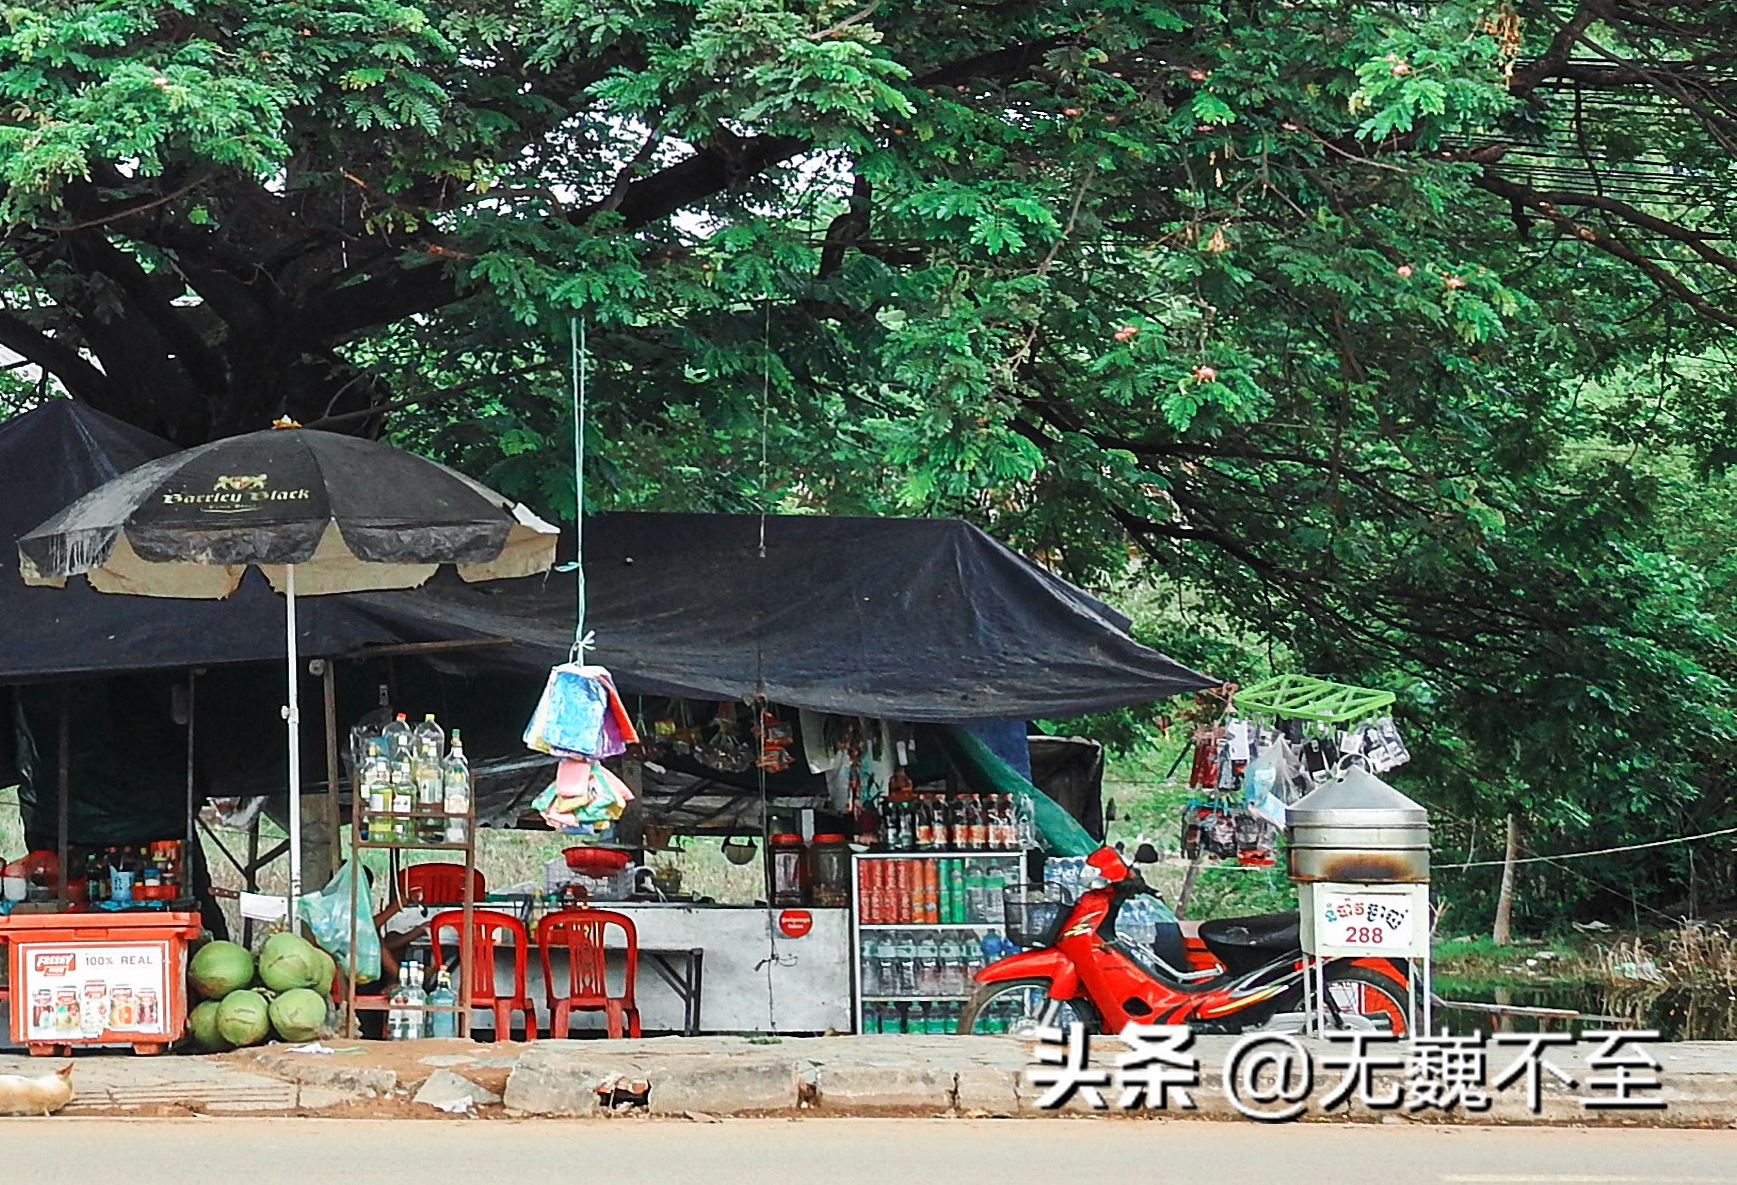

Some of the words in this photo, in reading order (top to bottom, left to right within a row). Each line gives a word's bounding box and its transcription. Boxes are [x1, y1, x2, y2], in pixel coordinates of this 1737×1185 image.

[1345, 926, 1384, 944] 288
[85, 956, 114, 966] 100%
[120, 955, 154, 965] REAL
